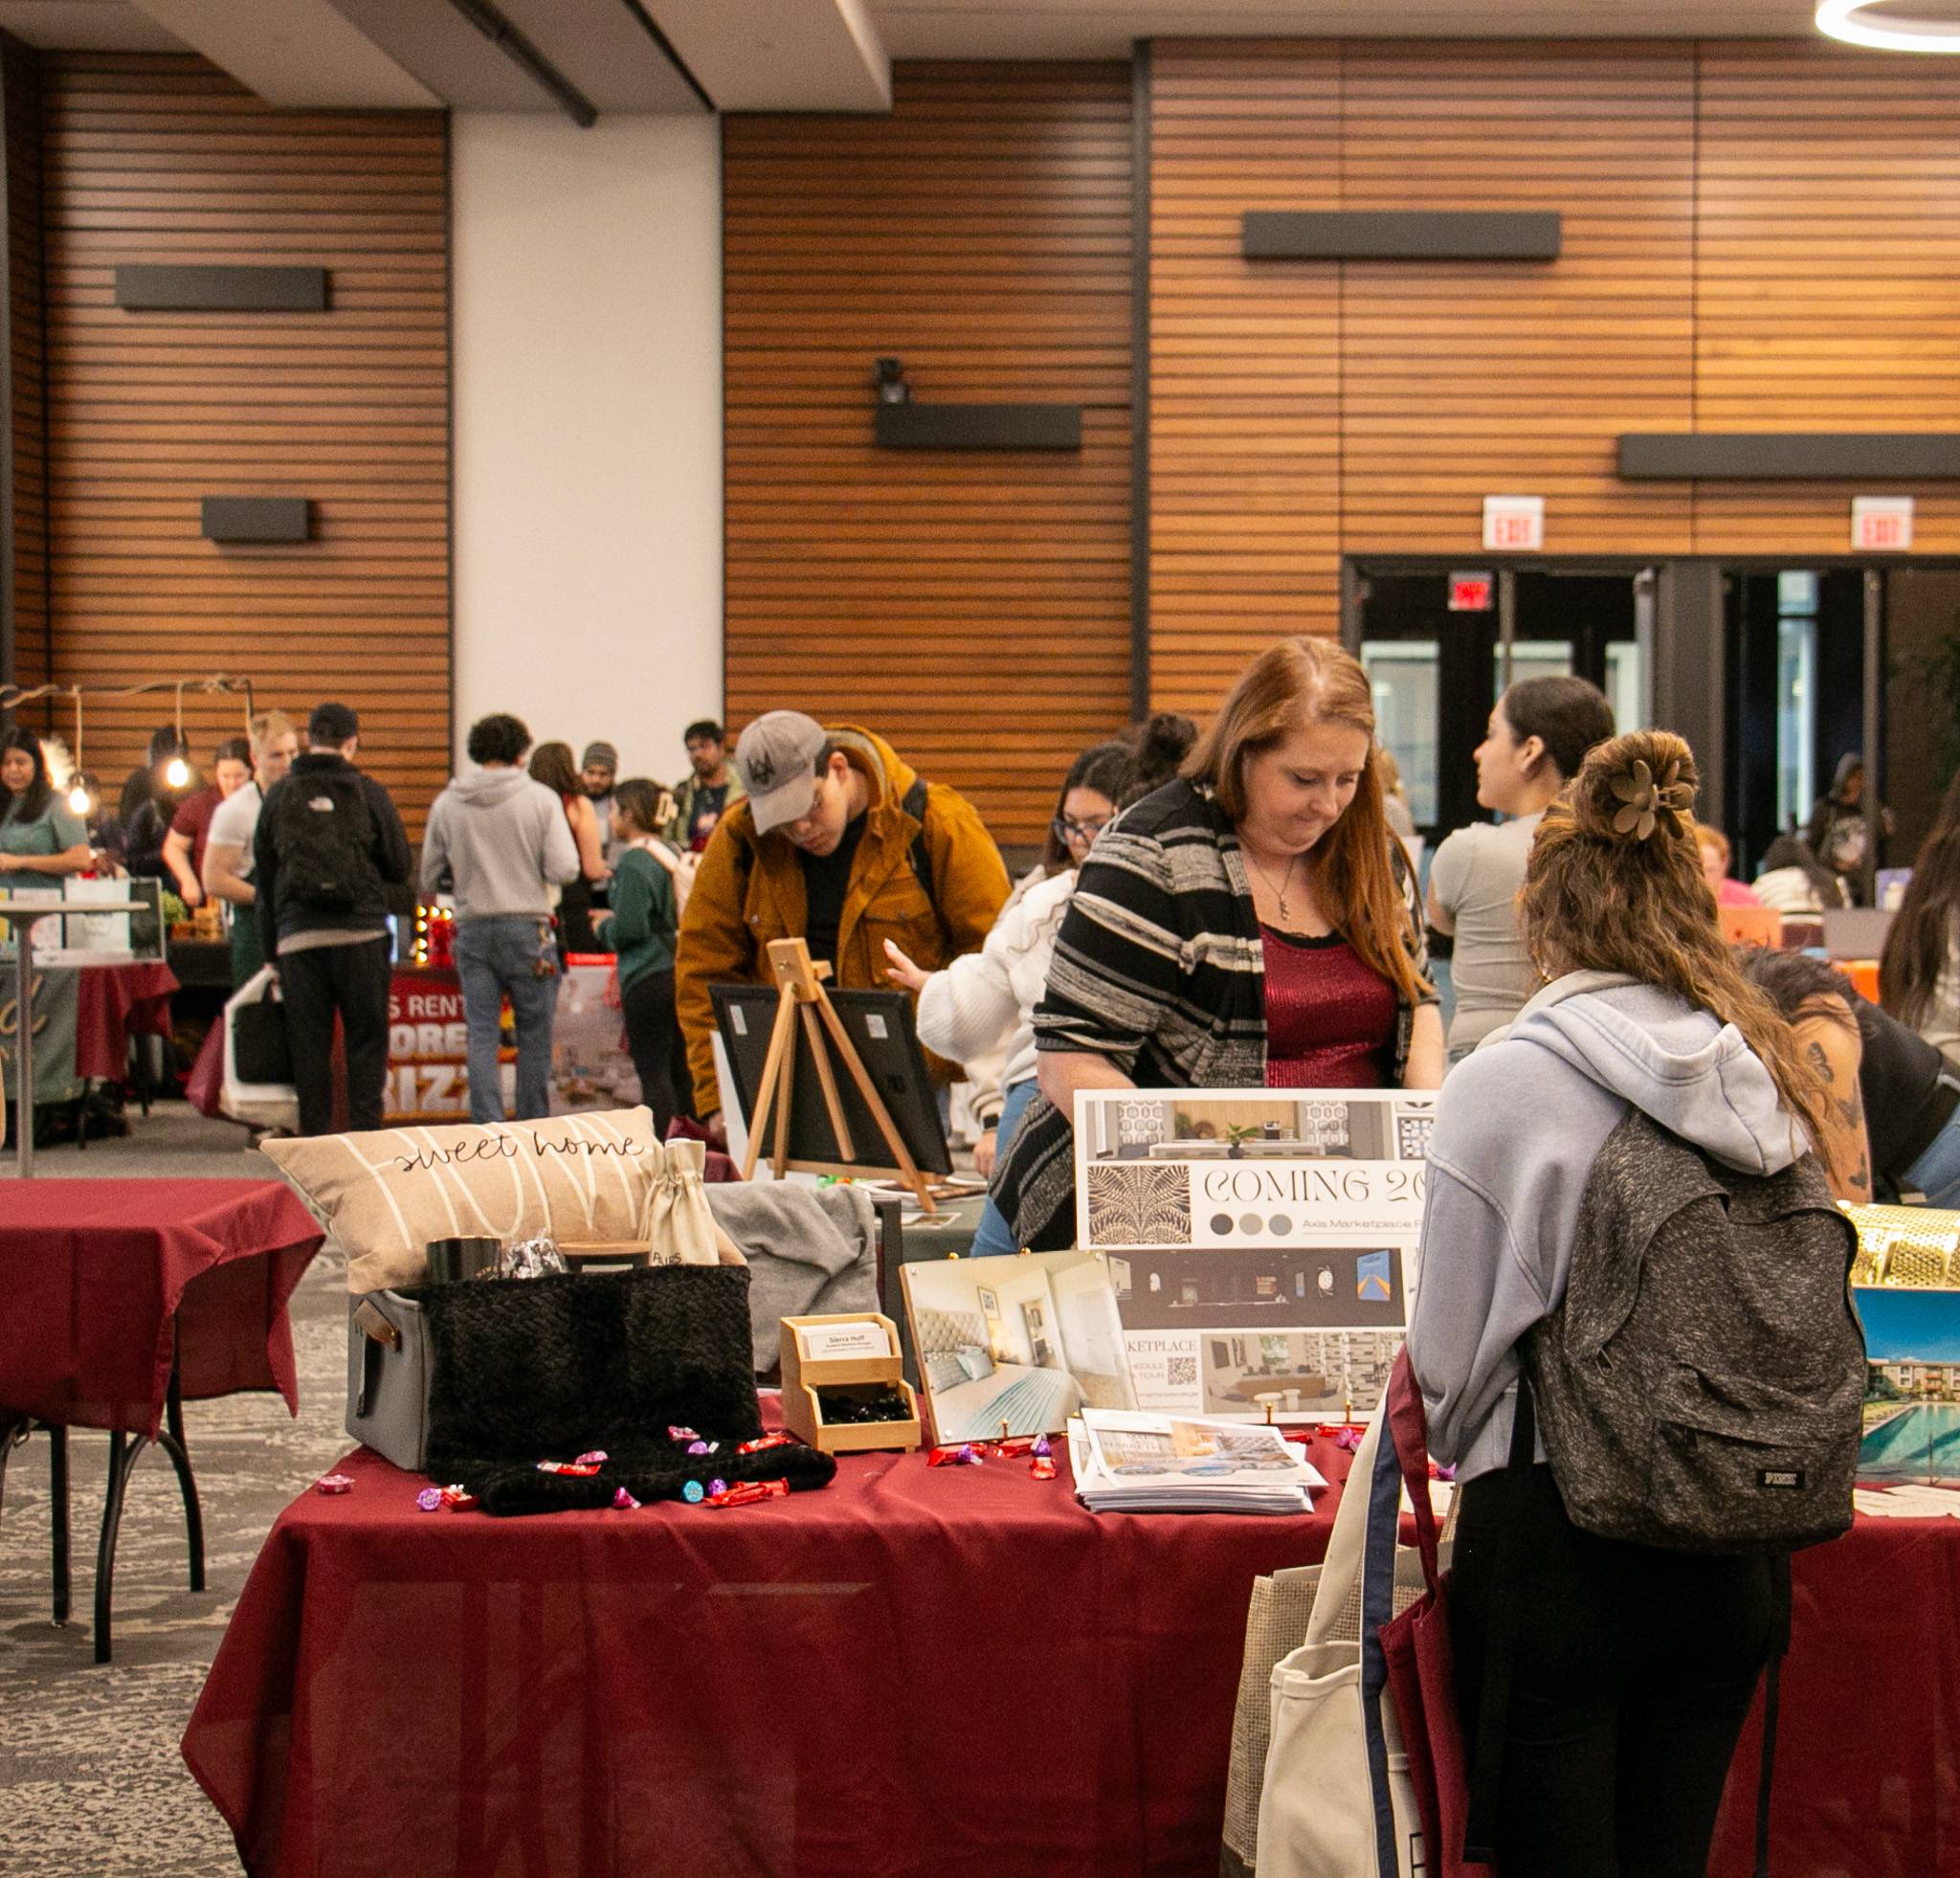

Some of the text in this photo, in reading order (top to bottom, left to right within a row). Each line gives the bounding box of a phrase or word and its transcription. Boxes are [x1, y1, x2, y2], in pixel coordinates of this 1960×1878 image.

[392, 1130, 646, 1173] sweet home
[1204, 1169, 1370, 1202] COMING
[1302, 1218, 1327, 1228] Axis
[1330, 1218, 1412, 1229] Marketplace
[1127, 1340, 1198, 1353] KETPLACE
